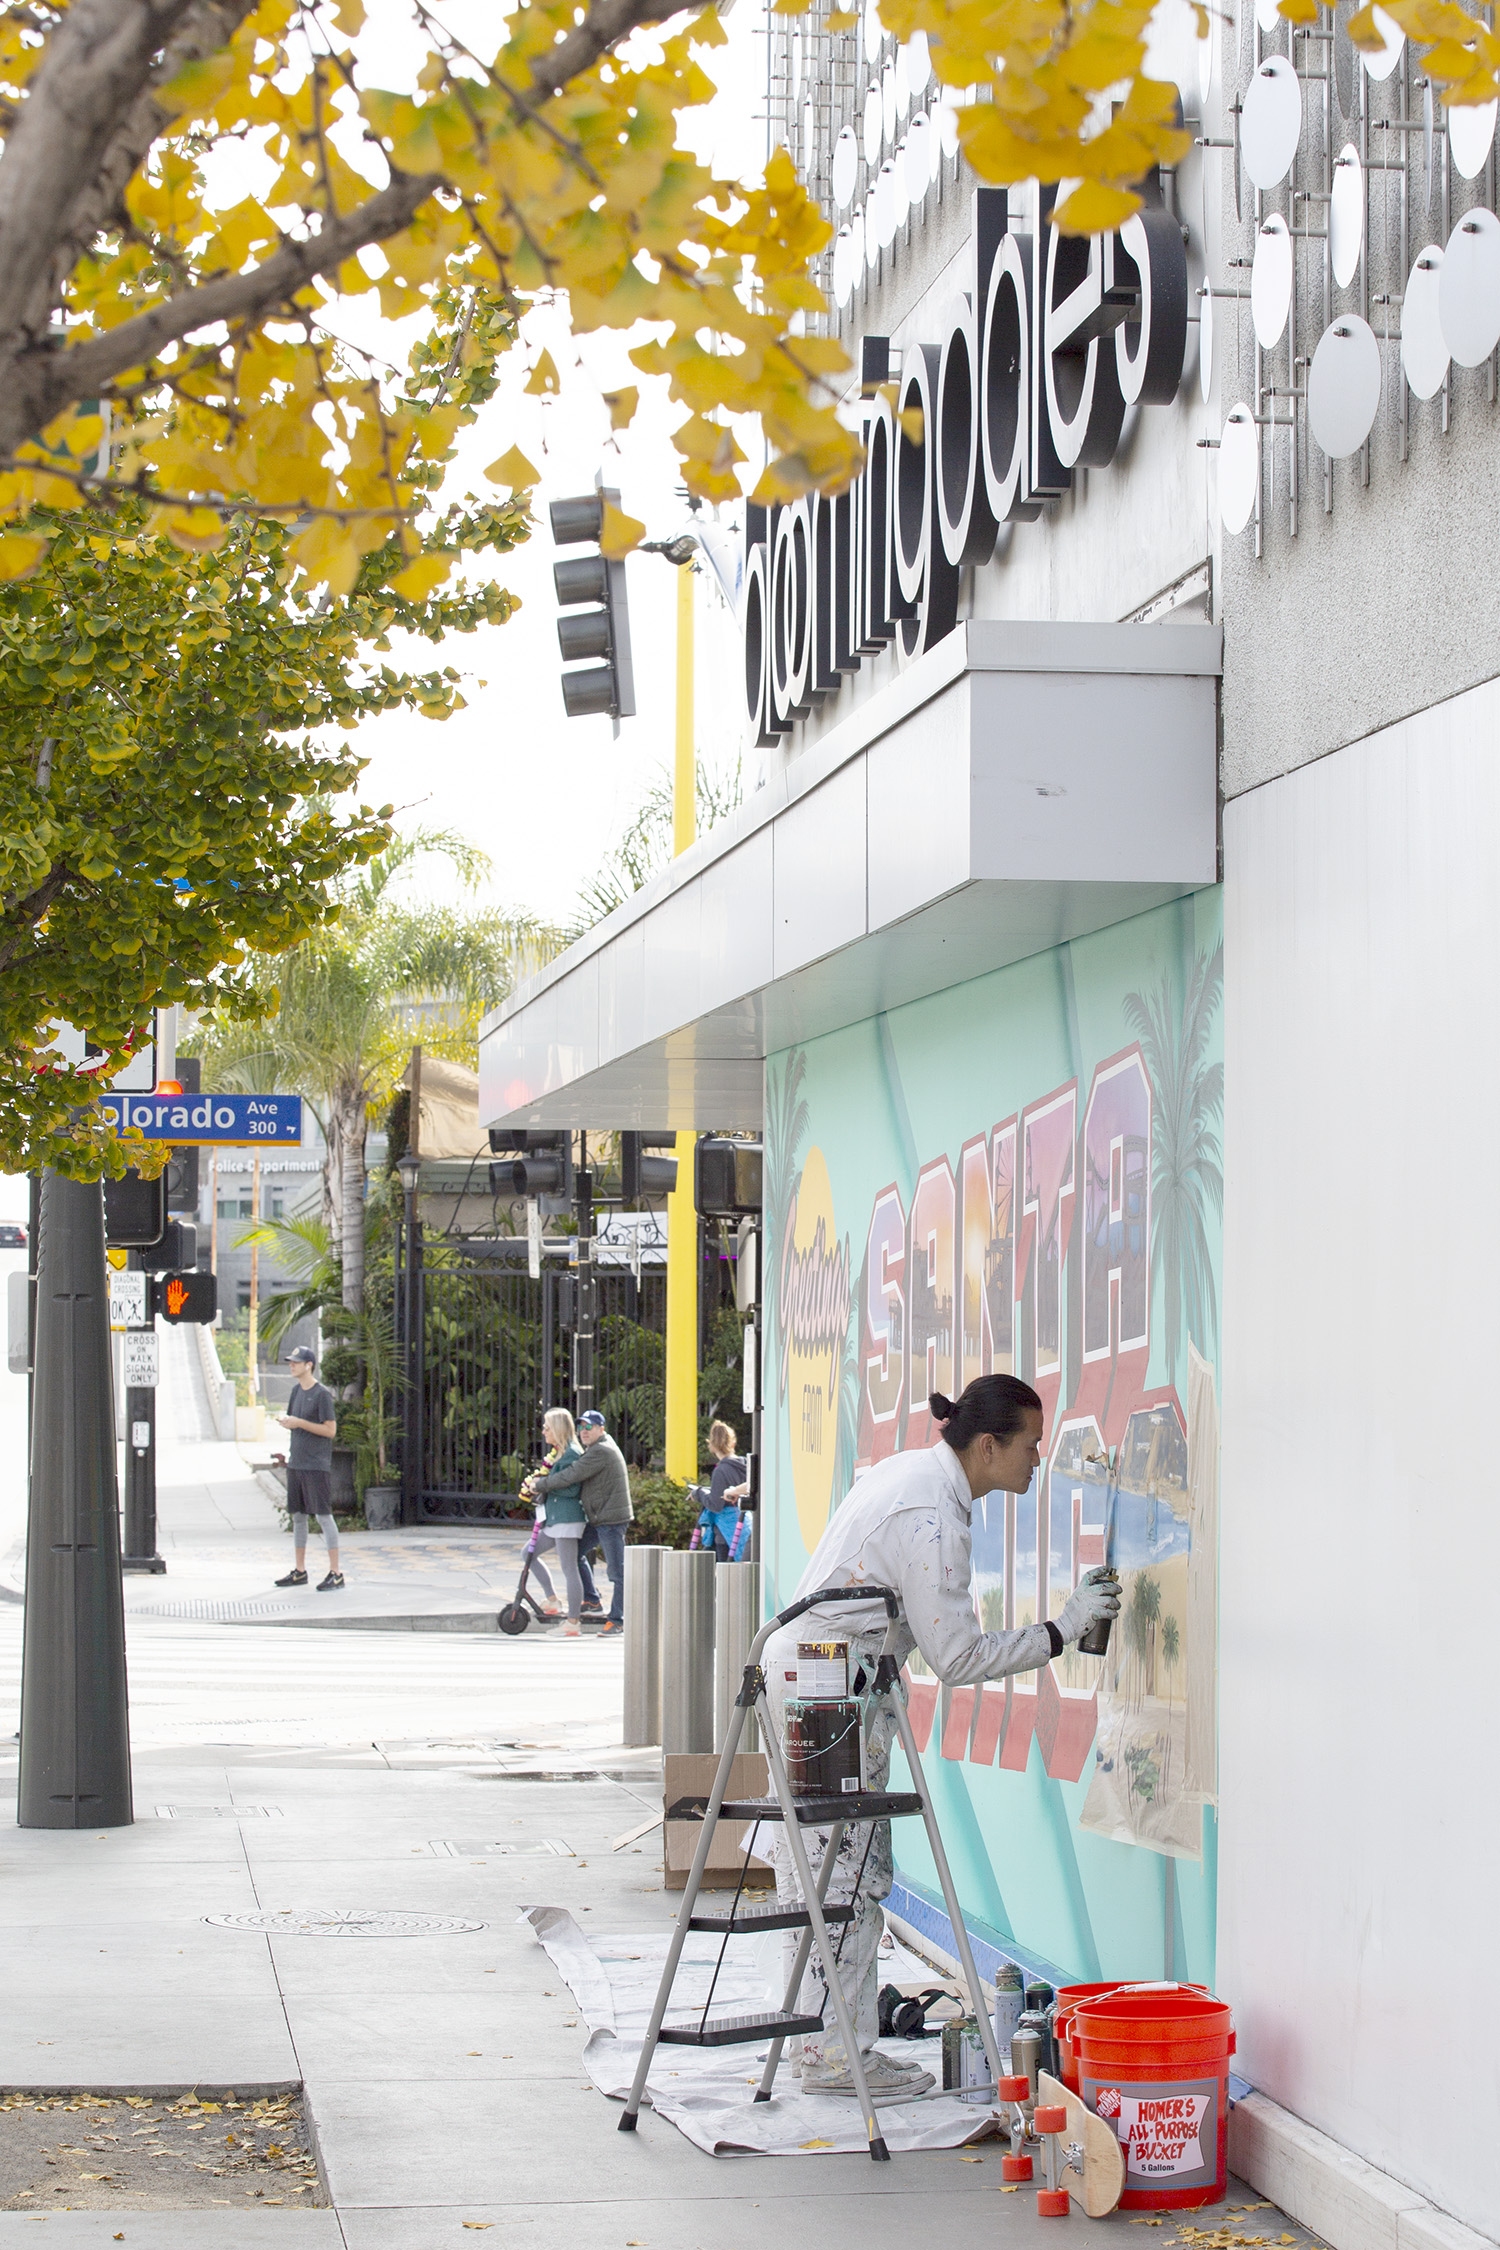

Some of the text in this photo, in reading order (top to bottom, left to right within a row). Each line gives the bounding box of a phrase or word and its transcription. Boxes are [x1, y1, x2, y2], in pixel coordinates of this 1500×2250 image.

[103, 1097, 278, 1129] olorado Ave
[248, 1121, 277, 1135] 300
[208, 1159, 244, 1172] Police
[866, 1042, 1152, 1425] SANTA
[113, 1275, 141, 1284] DIAGONAL
[113, 1285, 141, 1294] CROSSING
[778, 1185, 851, 1408] Greetings
[111, 1300, 124, 1320] OK
[127, 1336, 156, 1345] CROSS
[136, 1345, 146, 1353] ON
[129, 1354, 153, 1363] WALK
[126, 1364, 157, 1373] SIGNAL
[130, 1374, 153, 1383] ONLY
[801, 1384, 822, 1456] FROM
[786, 1739, 816, 1748] ARQUEE
[1096, 2088, 1121, 2117] HOME
[1104, 2099, 1121, 2117] DEPOT
[1138, 2097, 1196, 2123] HOMER'S
[1135, 2141, 1187, 2161] BUCKET
[1141, 2163, 1175, 2172] 5 Gallons
